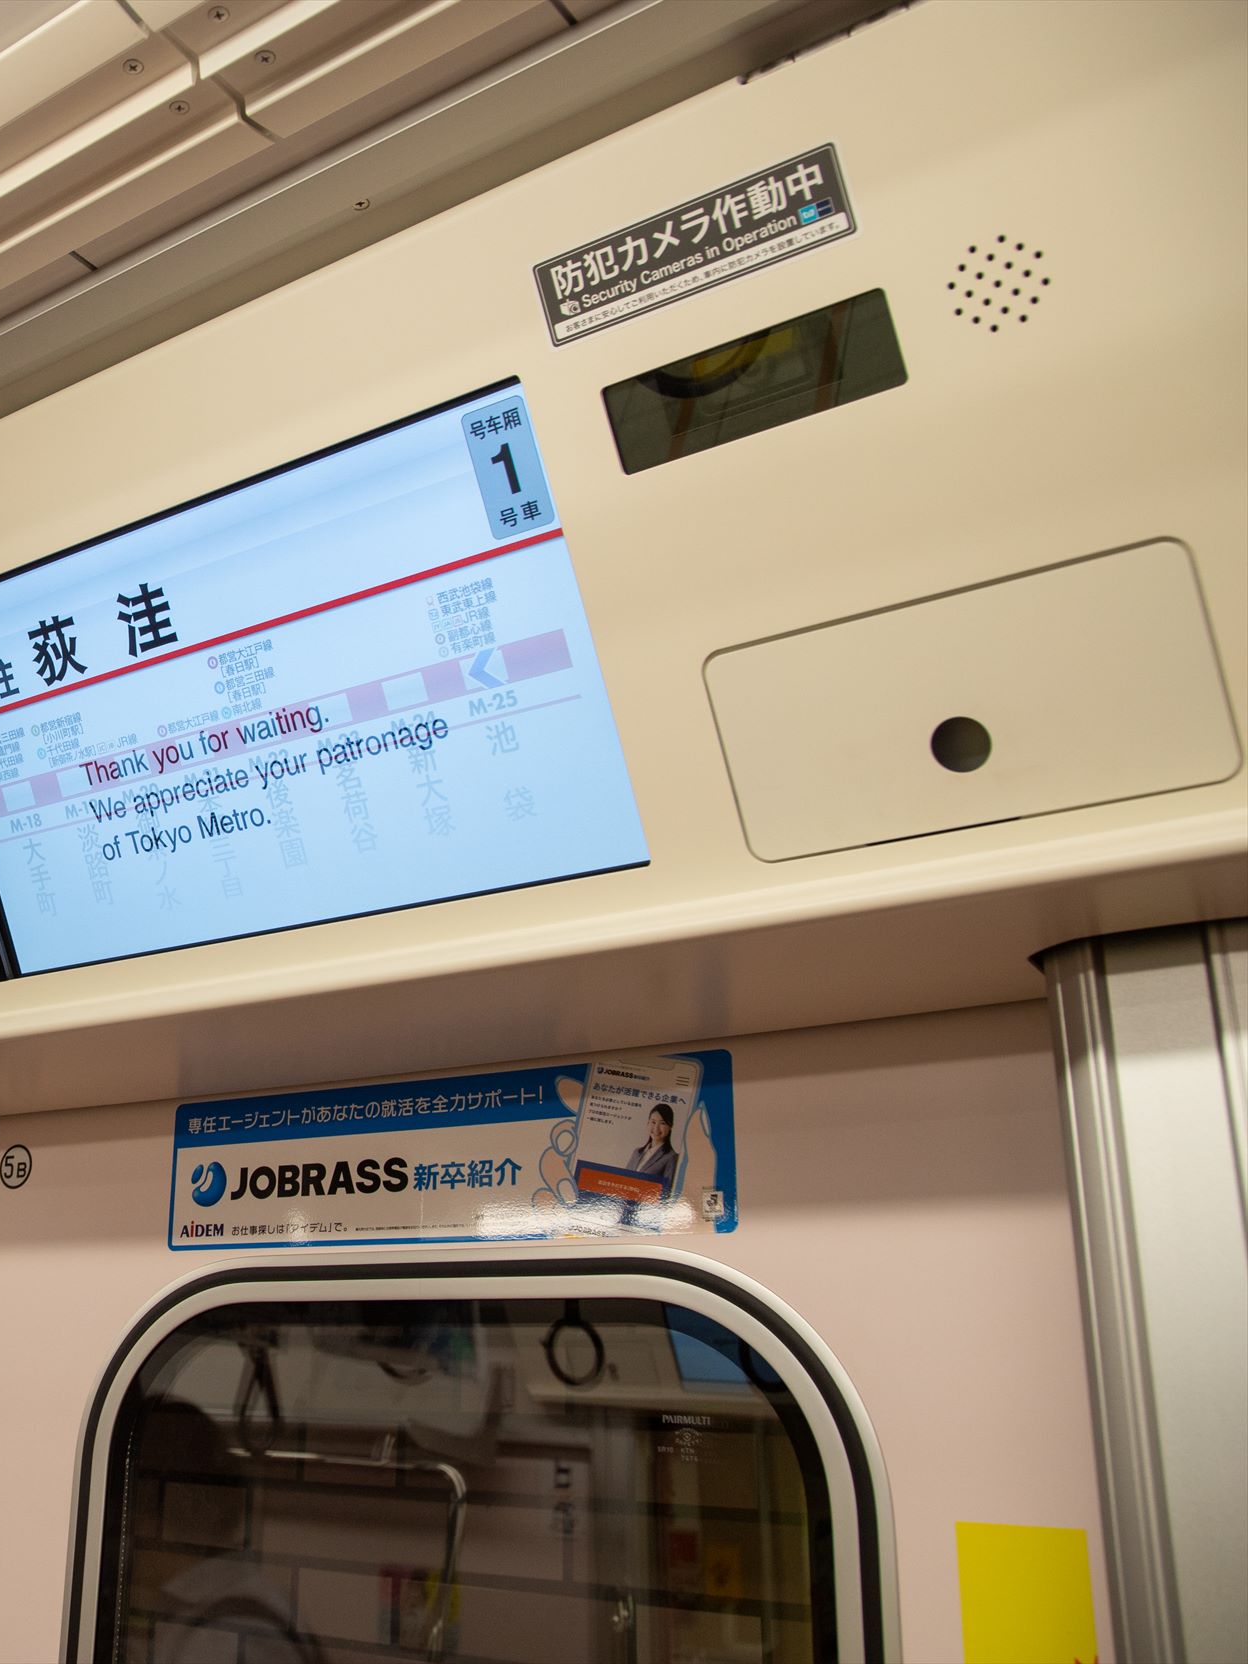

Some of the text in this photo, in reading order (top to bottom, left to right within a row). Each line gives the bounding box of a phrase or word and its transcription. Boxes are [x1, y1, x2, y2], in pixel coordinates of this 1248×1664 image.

[550, 164, 824, 300] 防犯カメラ作動中
[581, 215, 797, 308] Security Cameras in Operation
[469, 407, 522, 441] 号车厢
[491, 442, 522, 495] 1
[498, 500, 542, 528] 号車
[436, 577, 494, 605] 西武池袋線
[440, 591, 497, 617] 東武東上線
[27, 582, 179, 687] 荻洼
[468, 690, 518, 717] M-25
[79, 704, 330, 786] Thank you for waiting.
[89, 718, 448, 823] We appreciate your patronage
[10, 813, 43, 833] M-18
[103, 807, 272, 861] of Tokyo Metro.
[603, 1069, 633, 1079] JOBRASS
[593, 1082, 686, 1105] あなたが活躍できる企業へ
[188, 1085, 543, 1135] 専任エージェントがあなたの就活を全力サポート!
[4, 1156, 27, 1179] 5B
[230, 1157, 523, 1201] JOBRASS 新卒紹介
[180, 1220, 224, 1238] AiDEM
[662, 1414, 711, 1425] PAIRMULTI
